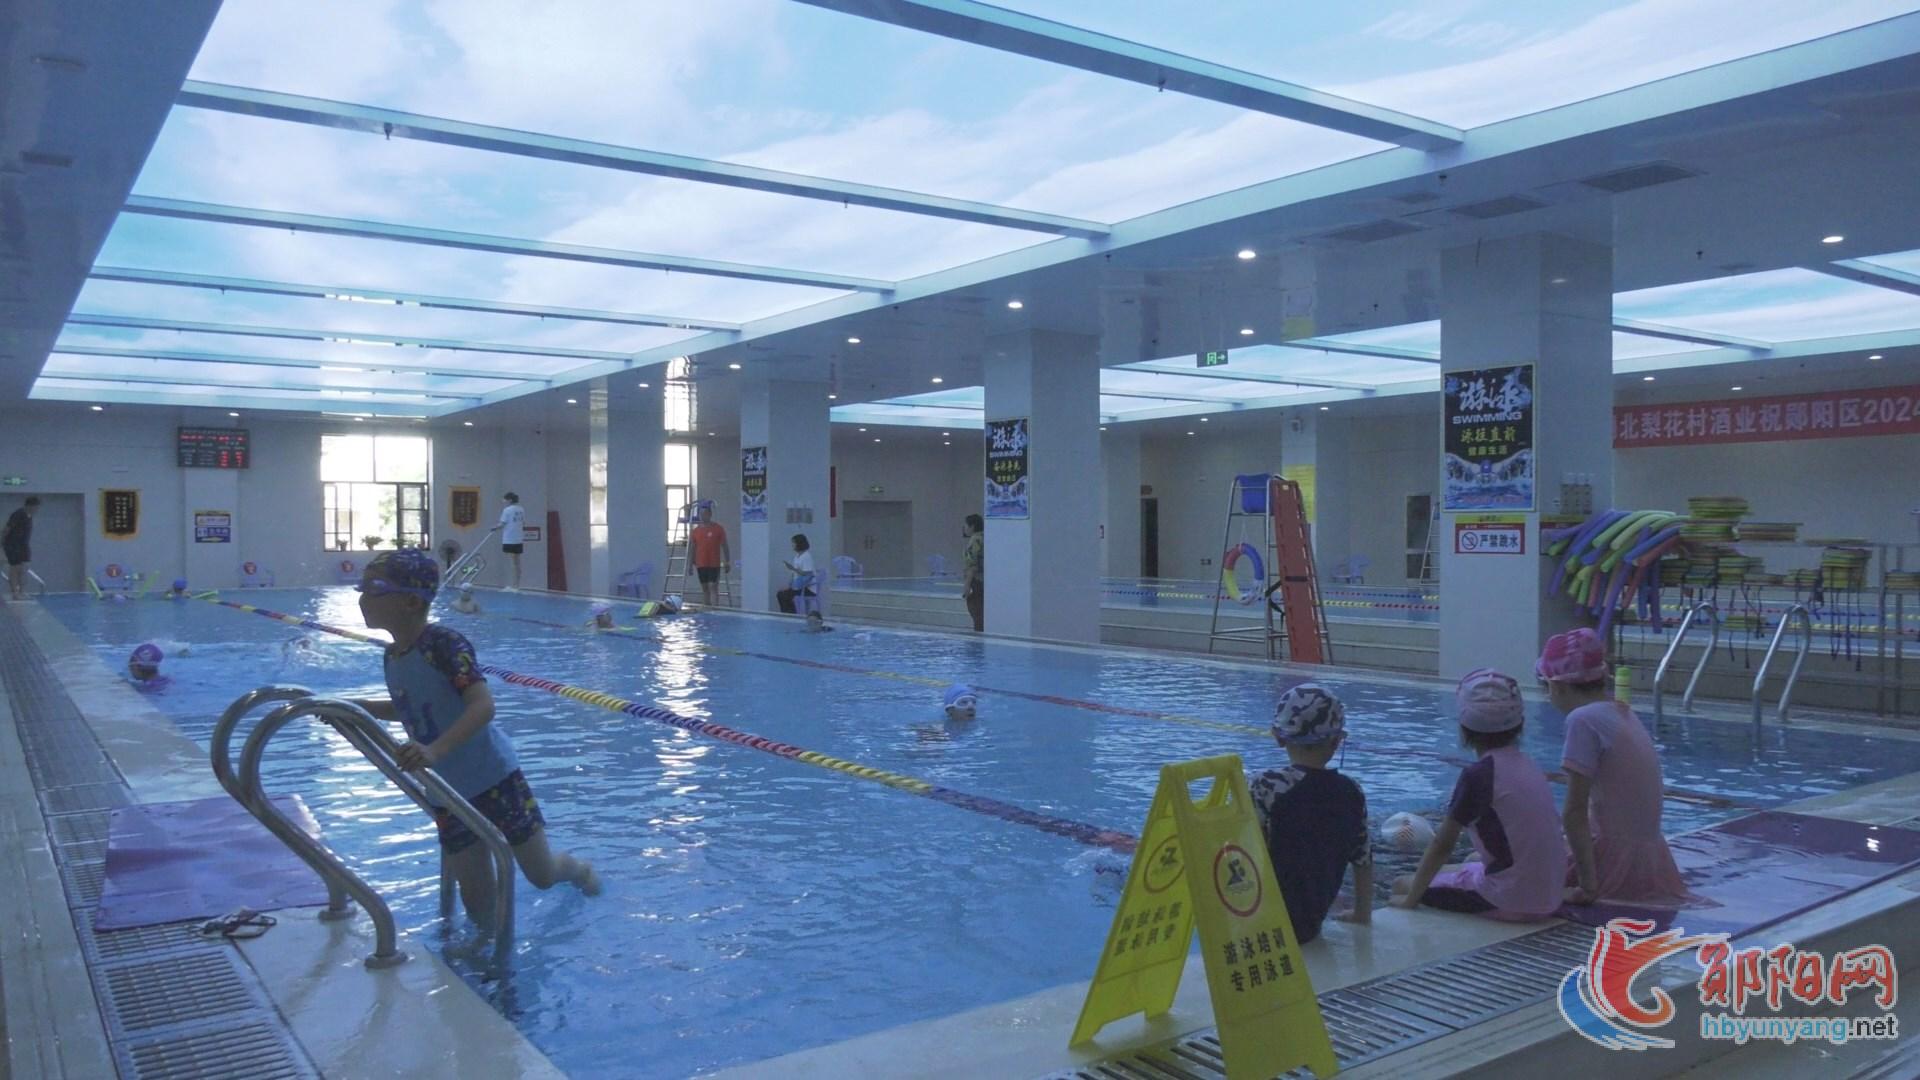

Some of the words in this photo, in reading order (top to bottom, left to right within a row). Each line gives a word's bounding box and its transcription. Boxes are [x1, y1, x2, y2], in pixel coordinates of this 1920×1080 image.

[1452, 411, 1522, 425] SWIMMING
[1479, 534, 1519, 549] 严禁跳水
[1223, 928, 1286, 966] 游泳培训
[1231, 954, 1295, 992] 专用泳道
